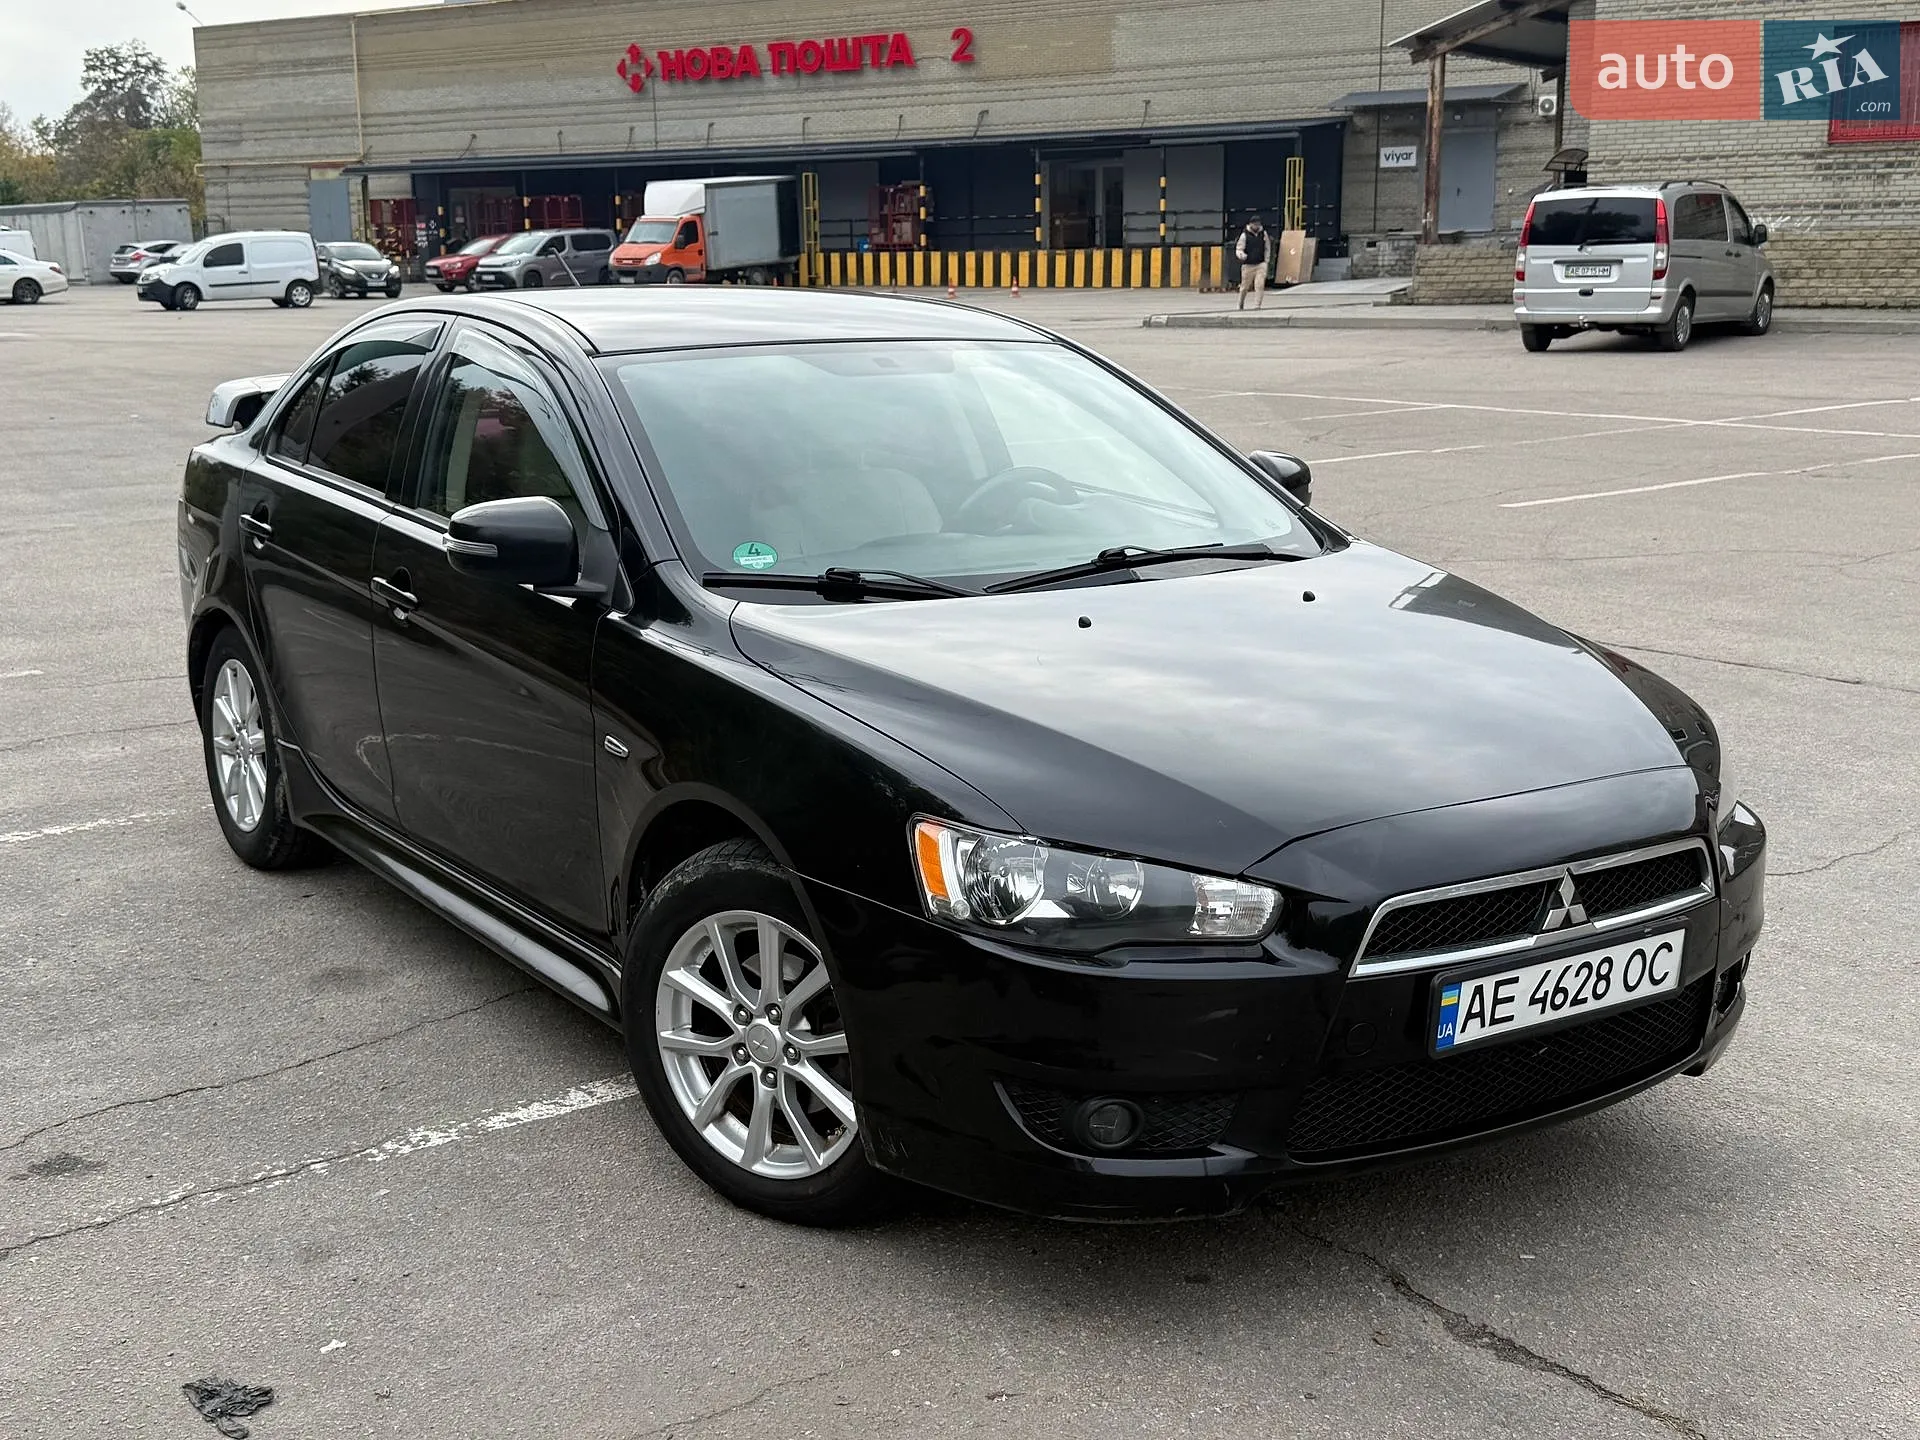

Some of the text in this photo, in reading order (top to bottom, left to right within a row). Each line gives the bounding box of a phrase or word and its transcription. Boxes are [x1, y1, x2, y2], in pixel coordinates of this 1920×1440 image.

[658, 28, 973, 81] НОВА ПОШТА 2
[1384, 150, 1414, 163] viyar
[748, 543, 761, 556] 4
[1460, 941, 1673, 1034] AE 4628 OC
[1437, 1025, 1453, 1039] UA
